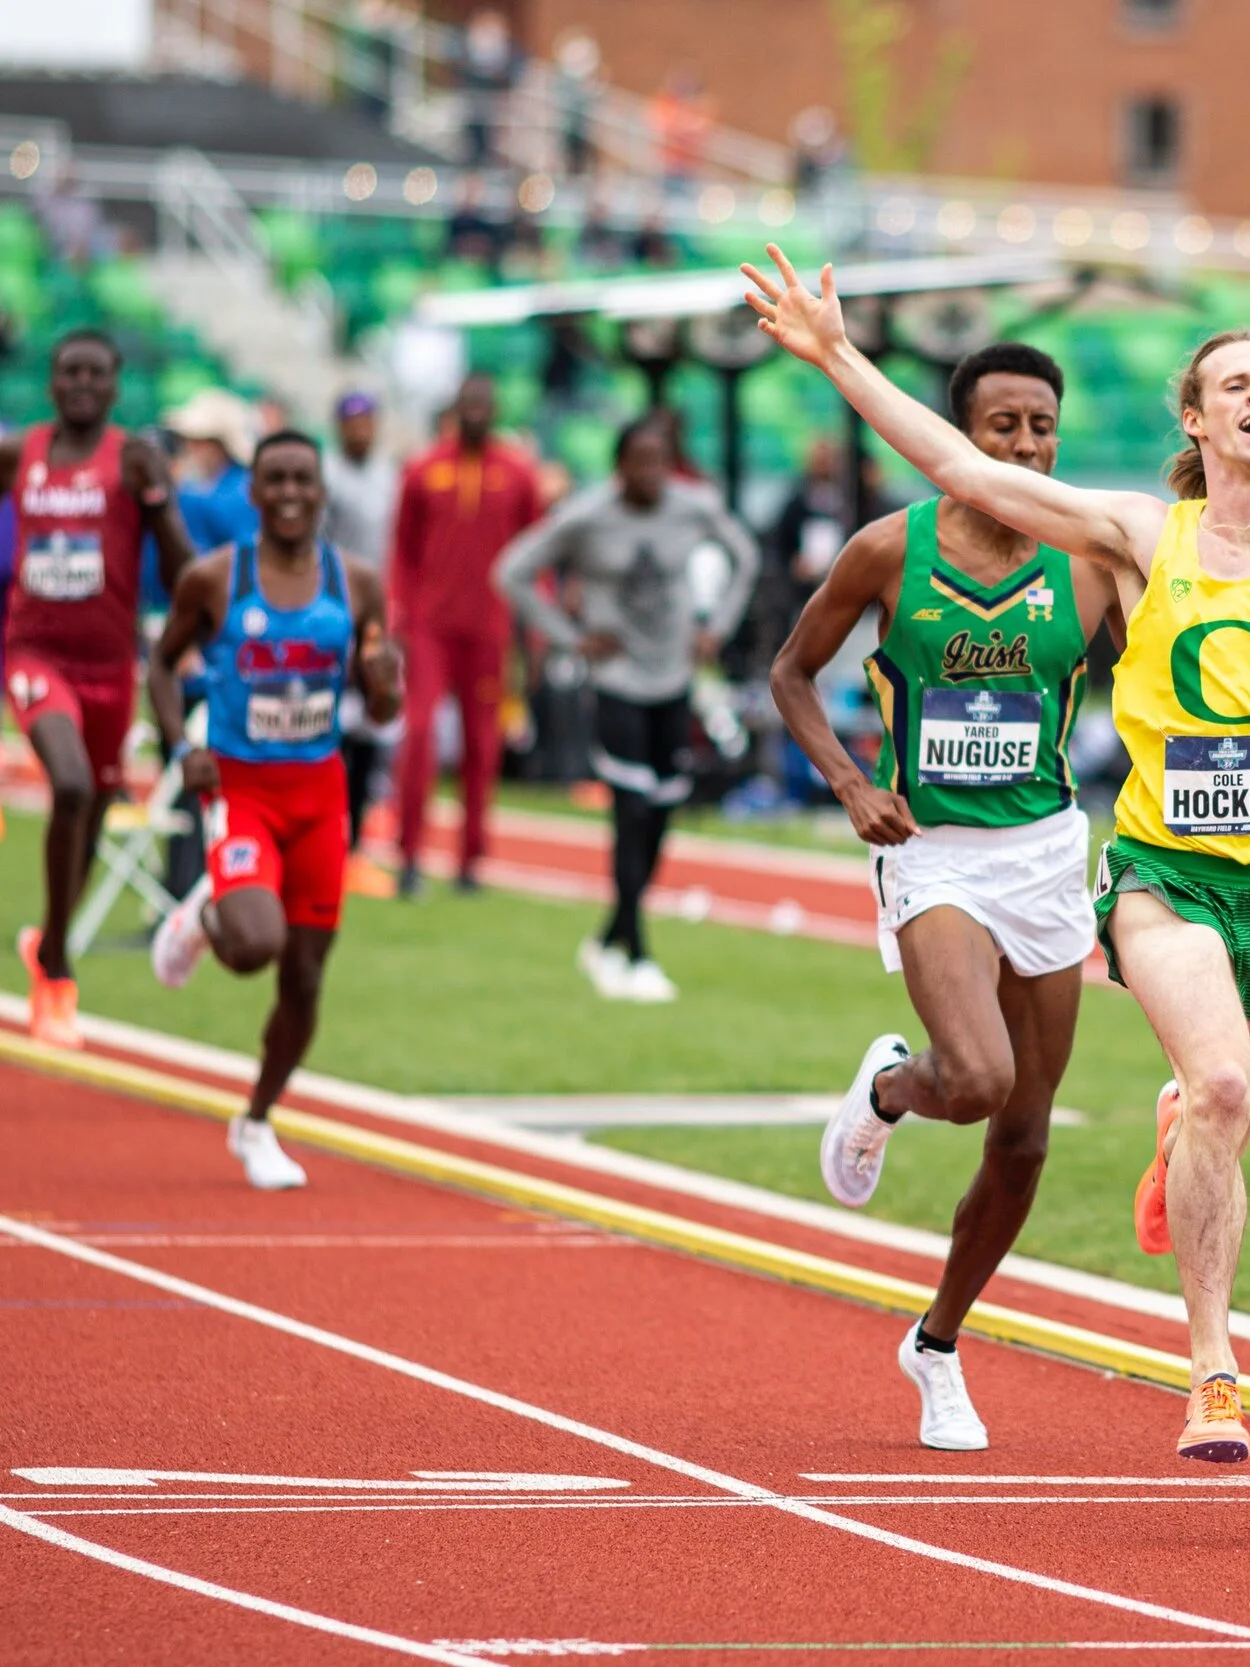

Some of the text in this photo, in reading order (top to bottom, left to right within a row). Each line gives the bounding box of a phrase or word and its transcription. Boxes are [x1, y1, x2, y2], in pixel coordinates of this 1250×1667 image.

[911, 608, 943, 620] ACC
[940, 629, 1033, 683] Irish
[964, 726, 999, 738] YARED
[926, 739, 1032, 767] NUGUSE
[1213, 774, 1243, 786] COLE
[1217, 824, 1232, 832] FIELD
